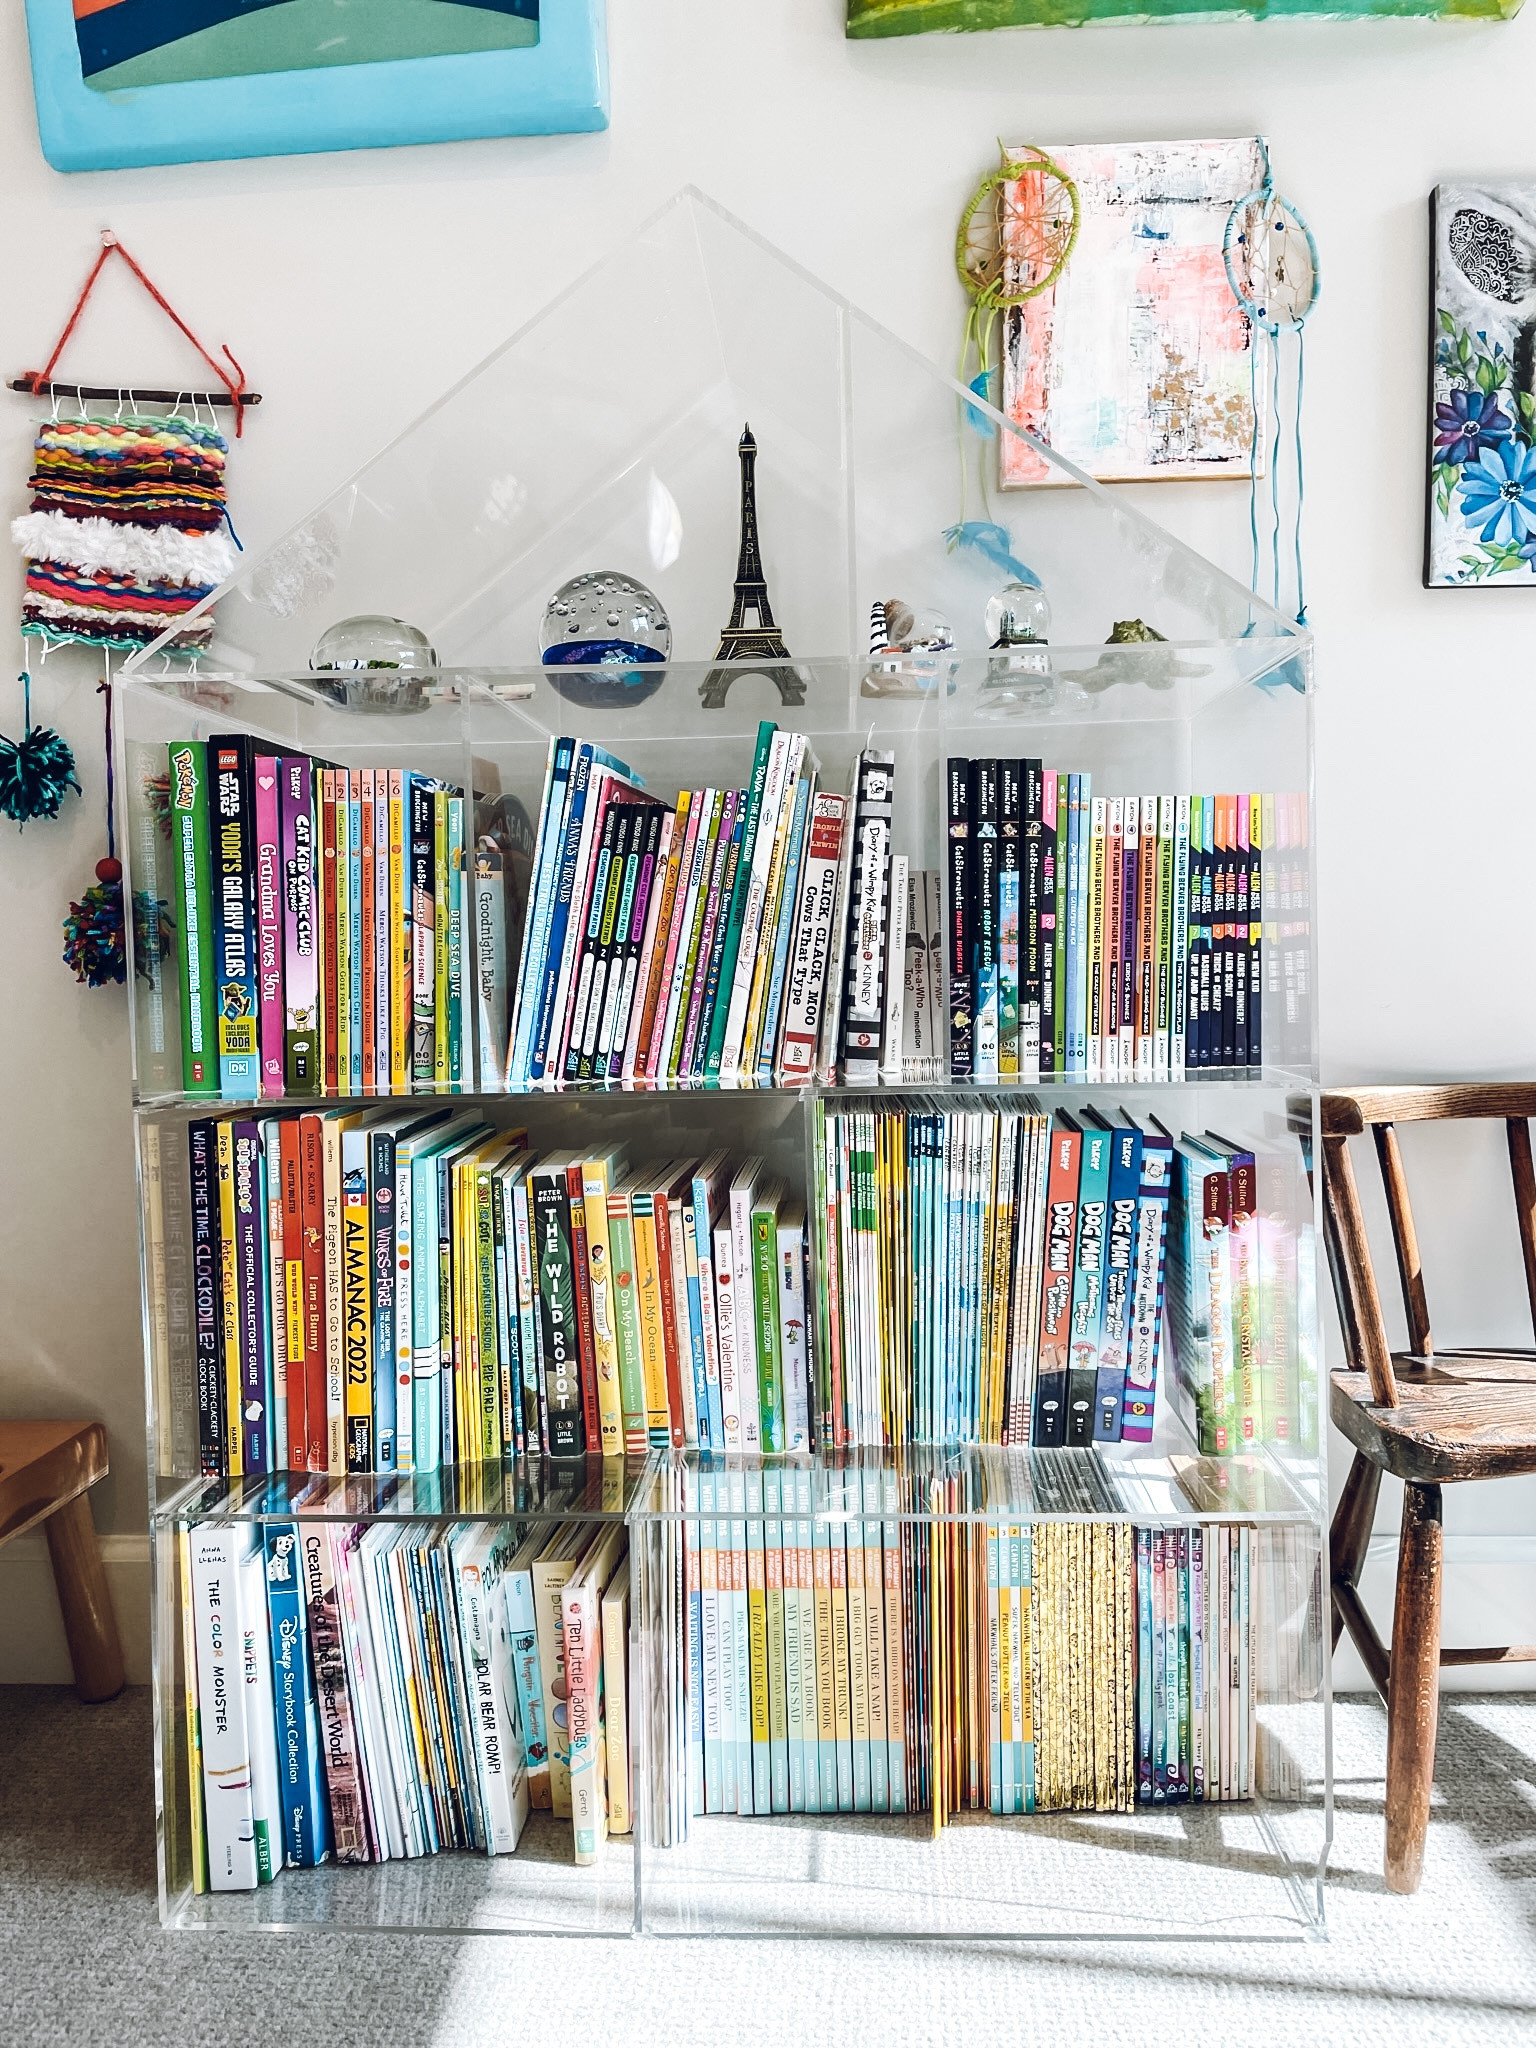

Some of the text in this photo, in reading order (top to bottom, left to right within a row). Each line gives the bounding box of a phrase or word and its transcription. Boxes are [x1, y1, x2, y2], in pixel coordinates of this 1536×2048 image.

[745, 481, 753, 554] PARIS
[220, 754, 238, 764] LEGO
[577, 756, 589, 791] FROZEN
[219, 772, 230, 814] WARS
[230, 772, 240, 816] STAR
[743, 766, 766, 862] RAYA DRAGON
[221, 822, 241, 872] YODA'S
[296, 814, 310, 842] CAT
[869, 827, 881, 853] Diary
[560, 860, 575, 903] FRIENDS
[692, 839, 706, 886] PURRMAIDS
[712, 840, 726, 888] PURRMAIDS
[183, 816, 202, 1053] SUPER EXTRA DELUXE ESSENTIAL HANDBOOK
[223, 876, 246, 977] GALAXY ATLAS
[260, 843, 280, 1001] Grandma Loves You
[299, 922, 312, 956] CLUB
[480, 892, 494, 1002] Goodnight, Baby
[792, 886, 818, 1005] Cows That Type
[804, 869, 834, 1026] CLICK, CLACK, MOO
[451, 910, 460, 998] DEEP SEA DIVE
[914, 952, 924, 1008] Peek-a-Who
[984, 941, 992, 972] RESCUE
[1225, 952, 1233, 997] ALIEN SCOUT
[861, 964, 872, 1005] KINNEY
[1200, 955, 1210, 1012] BASEBALL BLUES
[226, 1036, 250, 1046] YODA
[193, 1131, 206, 1177] WHAT'S
[220, 1135, 228, 1158] Dean
[269, 1138, 280, 1184] Willems
[195, 1178, 208, 1204] THE
[237, 1138, 253, 1214] SQUISHMALLOWS
[308, 1171, 316, 1206] SCARRY
[222, 1240, 232, 1261] Pete
[1049, 1202, 1074, 1272] DOG MAN
[1080, 1202, 1105, 1272] DOG MAN
[1111, 1200, 1135, 1268] DOG MAN
[1142, 1209, 1156, 1275] Diary Wimpy
[310, 1284, 317, 1301] am
[375, 1225, 394, 1307] WINGS FIRE
[196, 1244, 215, 1350] CLOCKODILE?
[244, 1224, 258, 1385] THE OFFICIAL COLLECTOR'S GUIDE
[325, 1197, 340, 1401] The Pigeon HAS School!
[346, 1220, 366, 1385] ALMANAC 2022
[545, 1208, 569, 1410] THE WILD ROBOT
[309, 1314, 319, 1352] Bunny
[620, 1290, 636, 1365] On My Beach
[645, 1306, 657, 1362] My Ocean
[720, 1293, 735, 1392] Ollie's Valentine
[1208, 1272, 1228, 1417] DRAGON PROPHECY
[277, 1344, 287, 1382] DRIVE!
[706, 1334, 716, 1381] Valentine?
[1138, 1339, 1148, 1378] KINNEY
[208, 1366, 218, 1438] CLICKETY-CLACKETY
[470, 1598, 481, 1640] Costamagna
[607, 1612, 618, 1657] Campbell
[208, 1580, 227, 1734] THE COLOR MONSTER
[244, 1631, 258, 1684] SNIPPETS
[306, 1537, 348, 1768] Creatures of the Desert World
[753, 1613, 764, 1728] REALLY LIKE SLOP!
[788, 1628, 800, 1723] FRIEND SAD
[820, 1626, 831, 1730] THANK BOOK
[836, 1616, 848, 1720] BROKE TRUNK!
[282, 1673, 295, 1726] Storybook
[567, 1620, 588, 1749] Ten Little Ladybugs
[805, 1686, 814, 1721] BOOK!
[1168, 1692, 1176, 1720] coast
[474, 1658, 500, 1774] POLAR BEAR ROMP!
[609, 1697, 620, 1732] Dear
[287, 1730, 298, 1783] Collection
[578, 1790, 588, 1816] Gerth
[259, 1837, 269, 1870] ALBER
